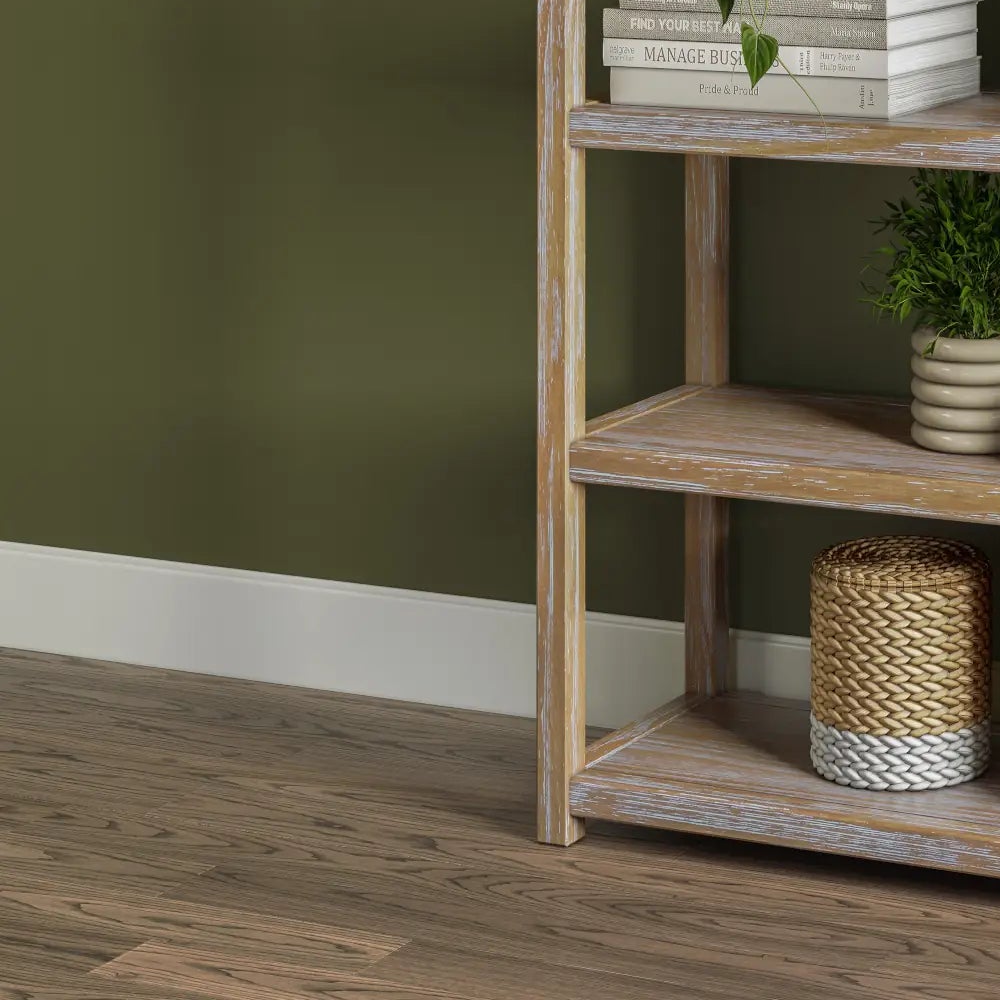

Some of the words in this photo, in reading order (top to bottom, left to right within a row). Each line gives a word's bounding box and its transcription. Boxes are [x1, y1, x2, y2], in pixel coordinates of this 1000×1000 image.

[630, 17, 656, 31] FIND
[659, 18, 689, 32] YOUR
[690, 19, 719, 33] BEST
[644, 46, 706, 65] MANAGE
[700, 83, 721, 94] Pride
[724, 85, 730, 94] &
[733, 85, 759, 96] Proud
